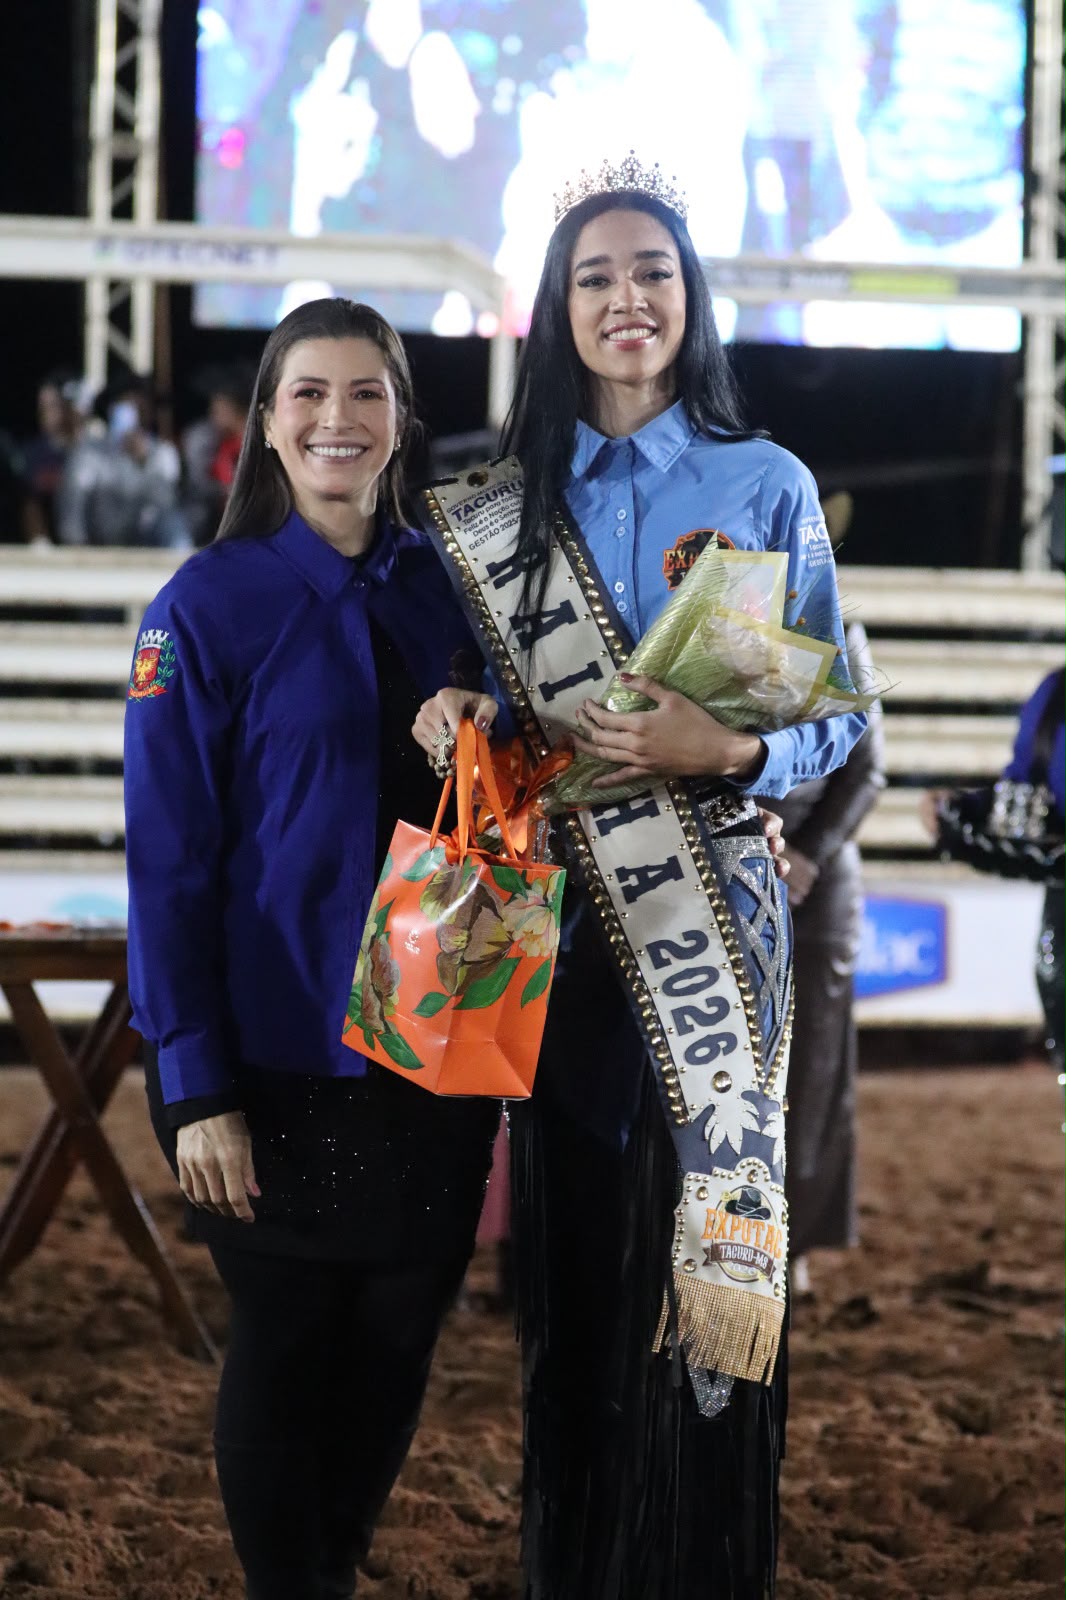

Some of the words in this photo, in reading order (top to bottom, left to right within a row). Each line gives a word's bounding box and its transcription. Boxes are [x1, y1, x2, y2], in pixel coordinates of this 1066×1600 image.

[451, 479, 524, 522] TACURU
[462, 509, 485, 525] Tacuru
[463, 523, 479, 535] Feliz
[468, 527, 500, 551] GESTÃO
[472, 524, 490, 537] Deus
[645, 929, 738, 1067] 2026
[701, 1207, 783, 1259] EXPOTAC
[720, 1243, 769, 1270] TACURU-MS
